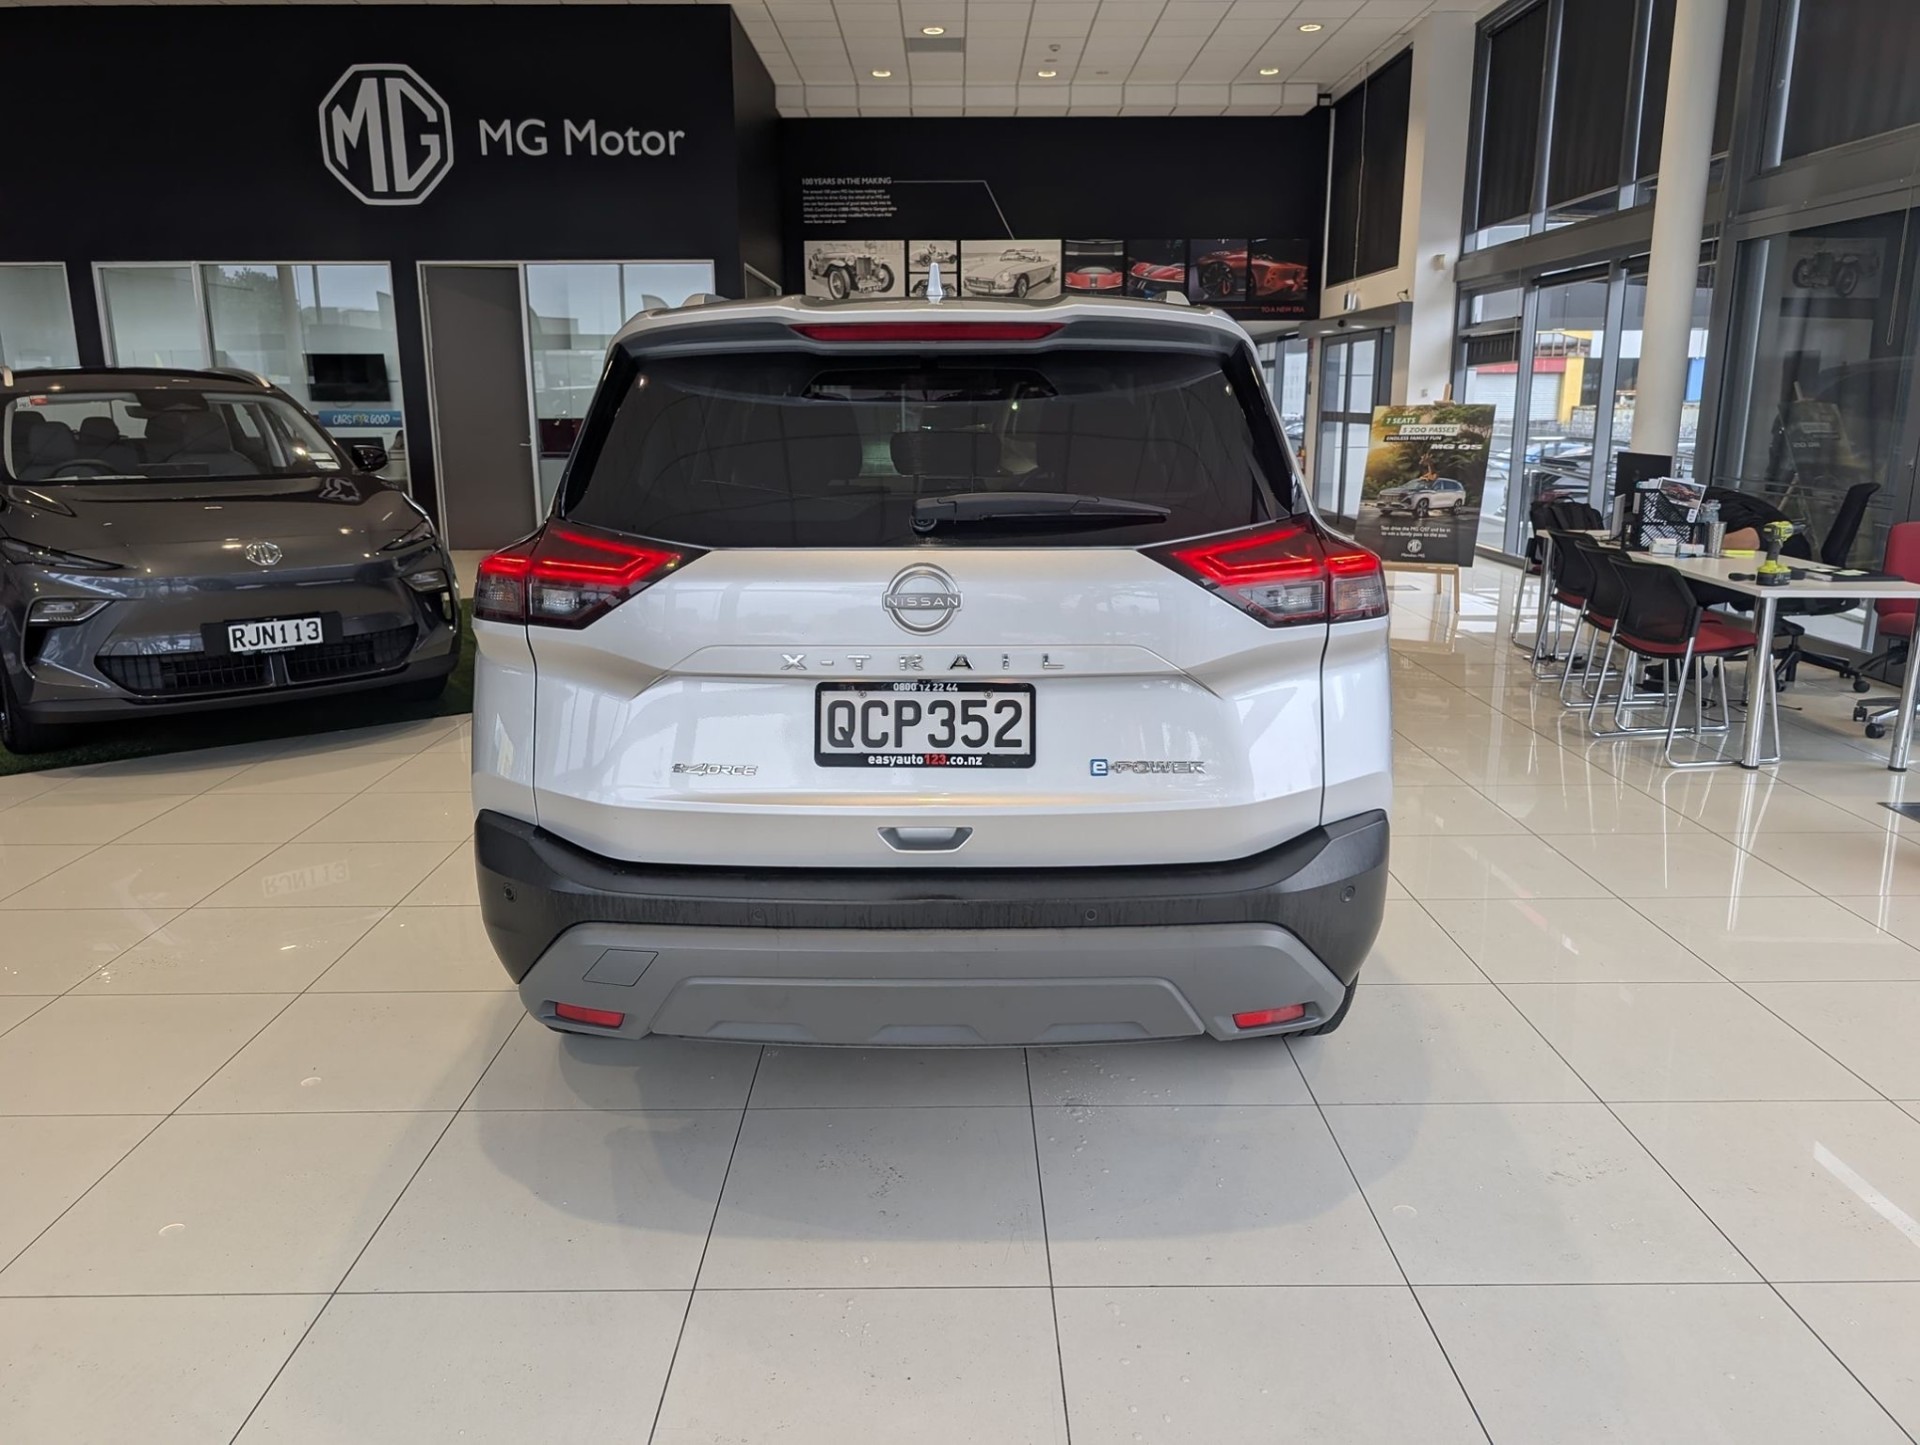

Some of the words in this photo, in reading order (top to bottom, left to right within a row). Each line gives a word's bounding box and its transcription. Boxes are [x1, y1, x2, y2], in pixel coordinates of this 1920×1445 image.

[330, 76, 442, 193] MG
[478, 118, 549, 157] MG
[563, 118, 686, 157] Motor
[814, 177, 836, 186] YEARS
[837, 177, 846, 186] IN
[846, 177, 860, 186] THE
[861, 176, 892, 186] MAKING
[332, 413, 352, 425] CARS
[369, 413, 391, 425] GOOD
[885, 596, 959, 607] NISSAN
[231, 621, 320, 649] RJN113
[780, 653, 1066, 671] X-TRAIL
[892, 682, 917, 692] 0800
[919, 683, 931, 692] 12
[932, 683, 945, 692] 22
[946, 683, 959, 692] 44
[827, 699, 1023, 748] QCP352
[867, 754, 983, 767] easyauto123.co.nz
